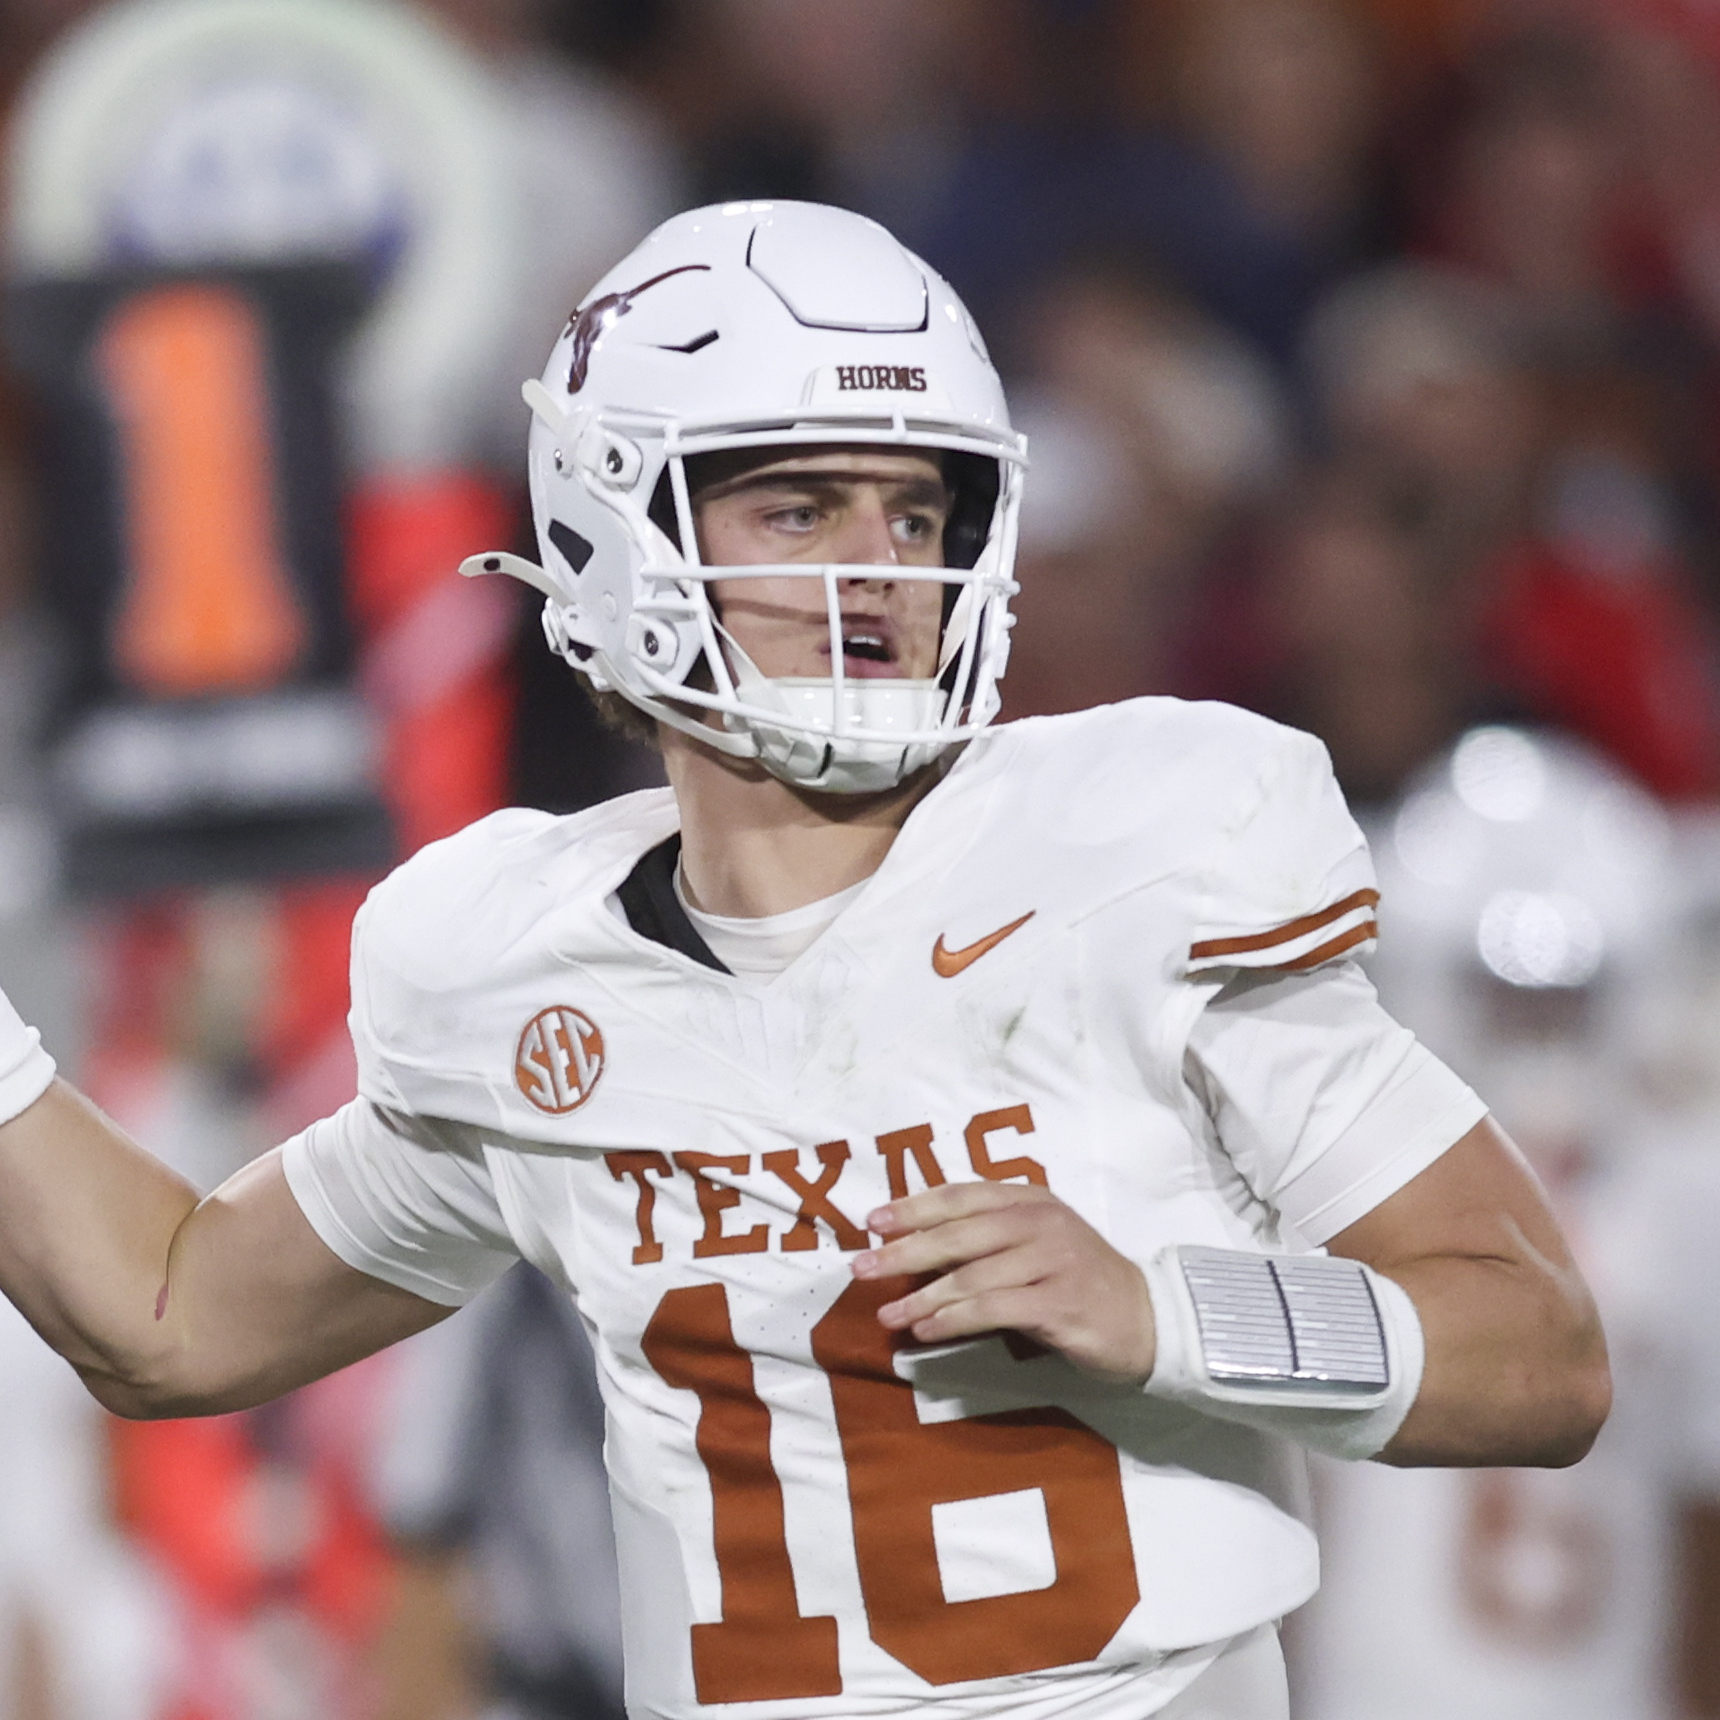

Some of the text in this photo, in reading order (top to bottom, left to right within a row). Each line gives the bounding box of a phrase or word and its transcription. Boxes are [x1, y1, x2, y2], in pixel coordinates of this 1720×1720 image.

[835, 364, 927, 392] HORNS
[91, 280, 311, 700] 1
[519, 1008, 602, 1109] SEC
[604, 1103, 1051, 1266] TEXAS
[640, 1262, 1141, 1705] 16
